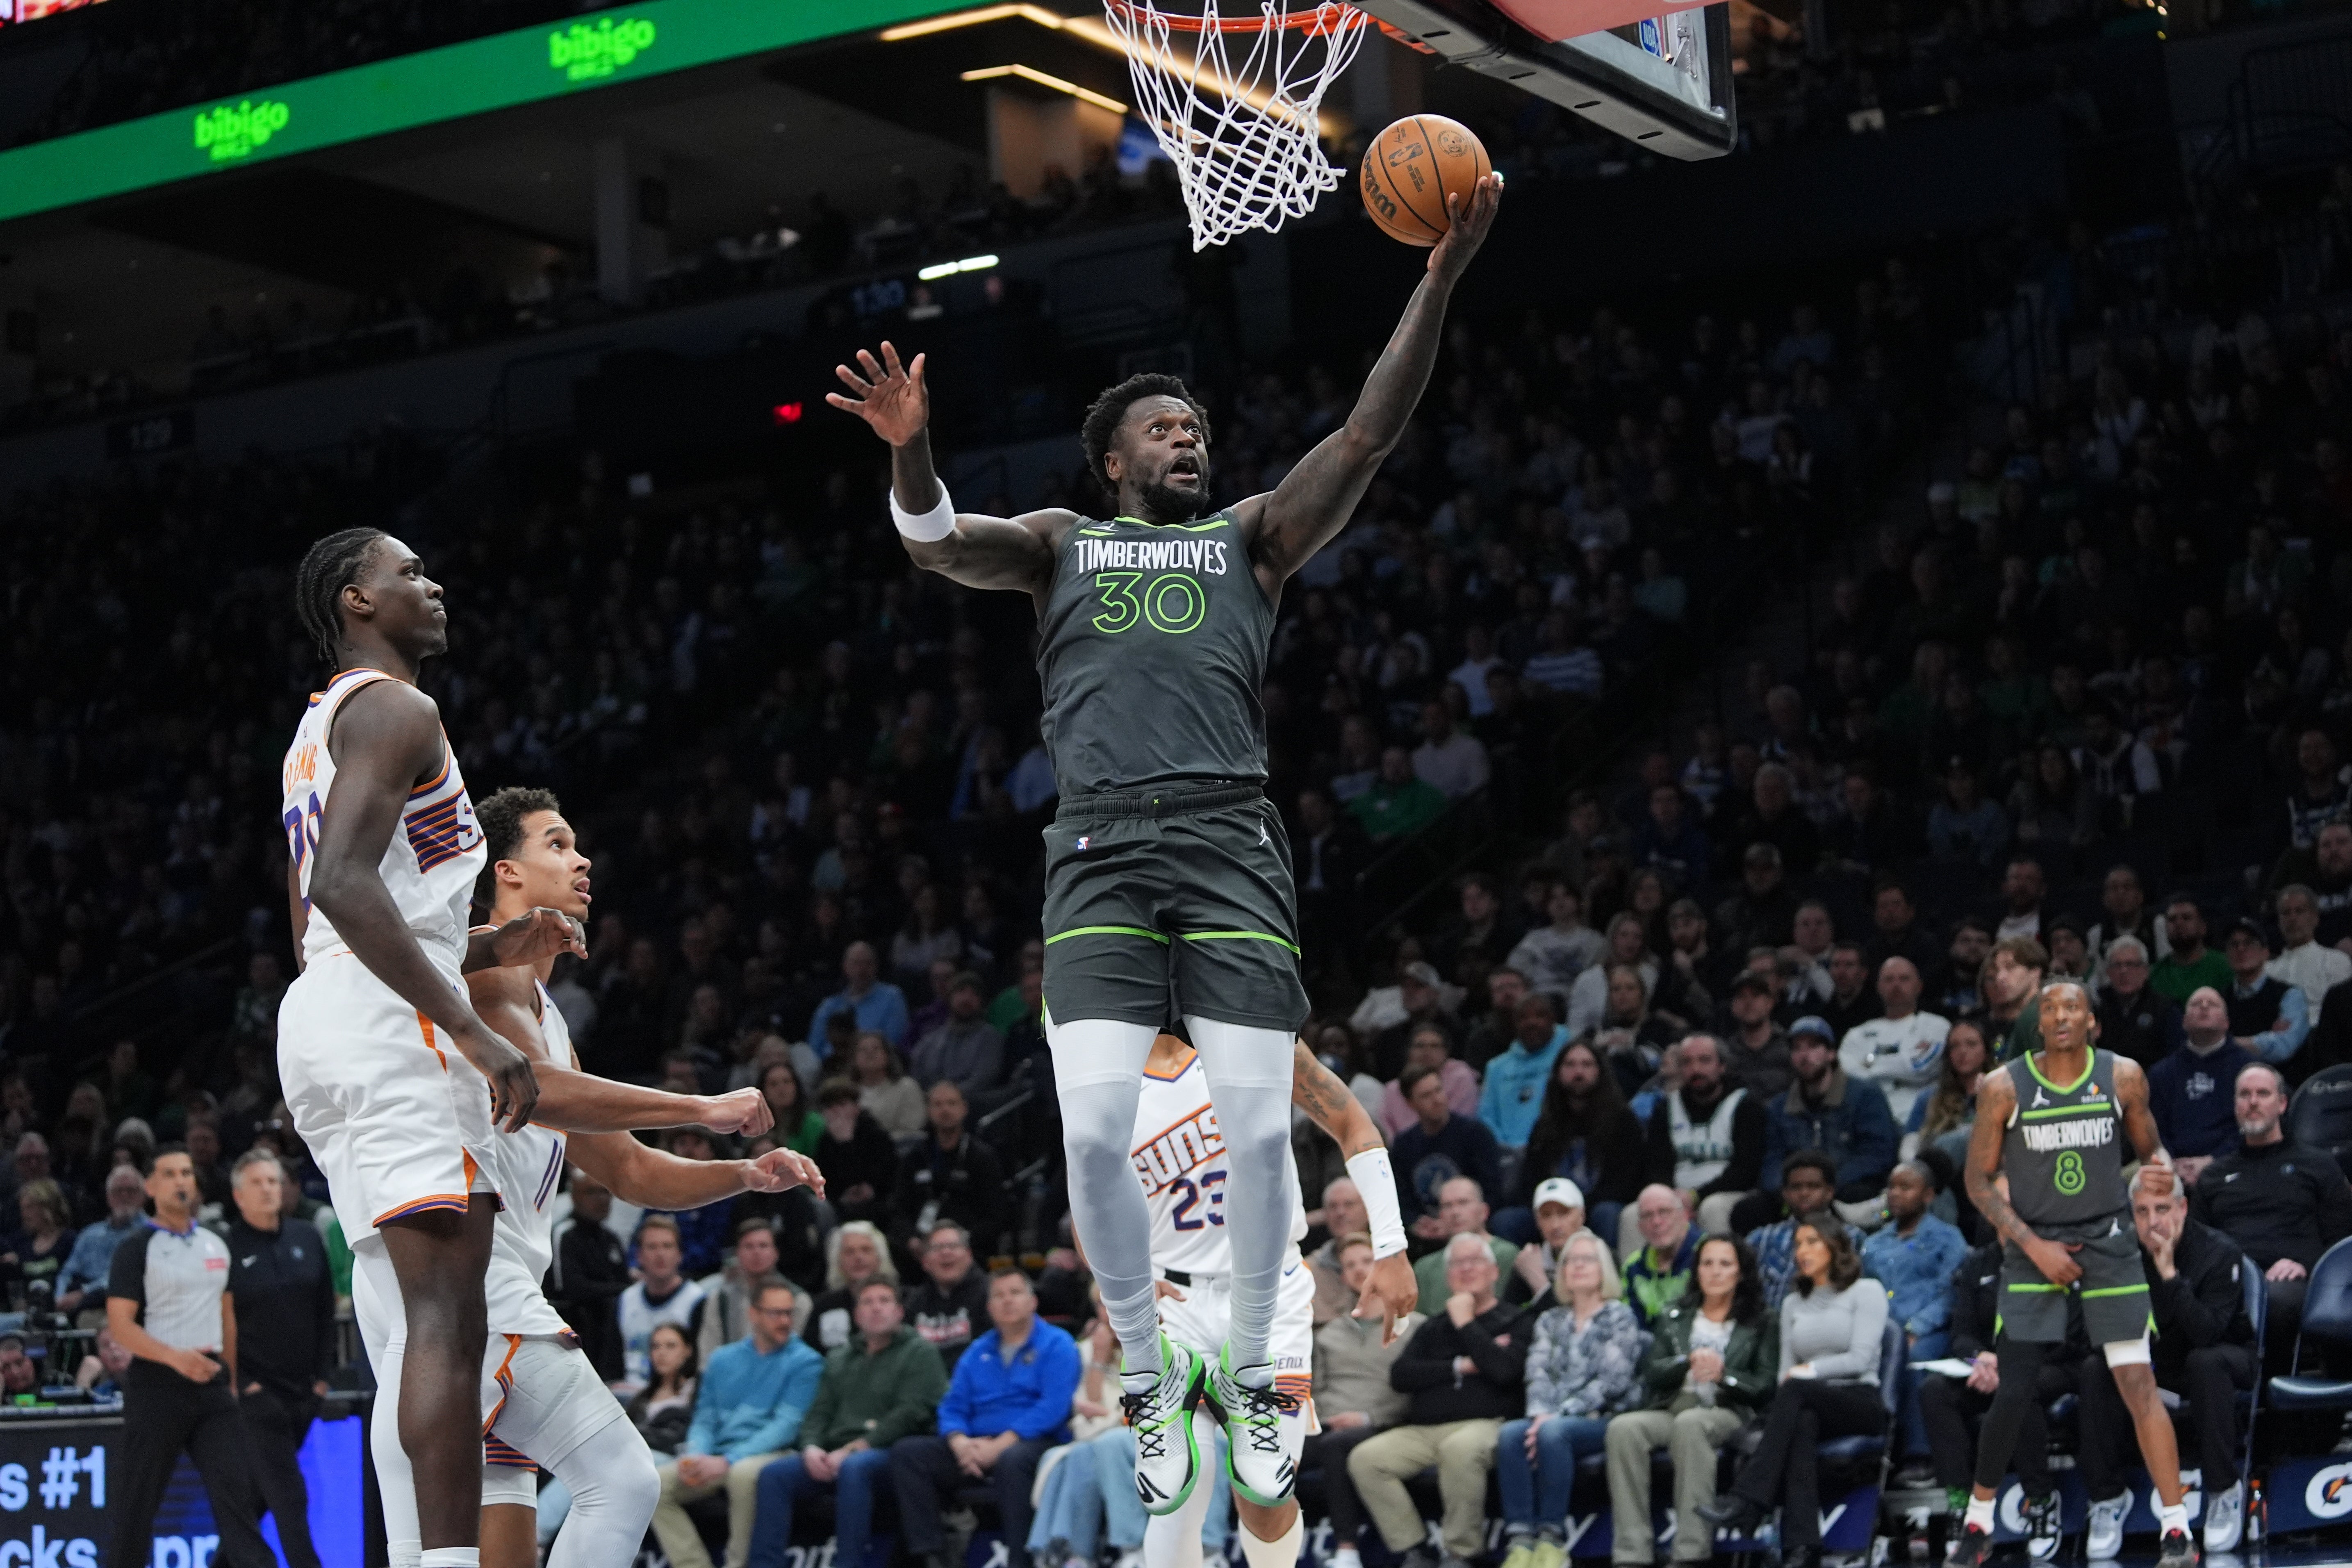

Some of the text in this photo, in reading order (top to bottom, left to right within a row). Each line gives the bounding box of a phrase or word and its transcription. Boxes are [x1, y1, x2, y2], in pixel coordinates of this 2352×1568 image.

[549, 18, 655, 68] bibigo
[195, 100, 289, 148] bibigo
[1075, 539, 1227, 575] TIMBERWOLVES
[1092, 572, 1205, 633] 30
[2022, 1117, 2114, 1154] TIMBERWOLVES
[2054, 1150, 2086, 1196] 8
[1170, 1170, 1228, 1231] 23
[39, 1445, 105, 1509] #1
